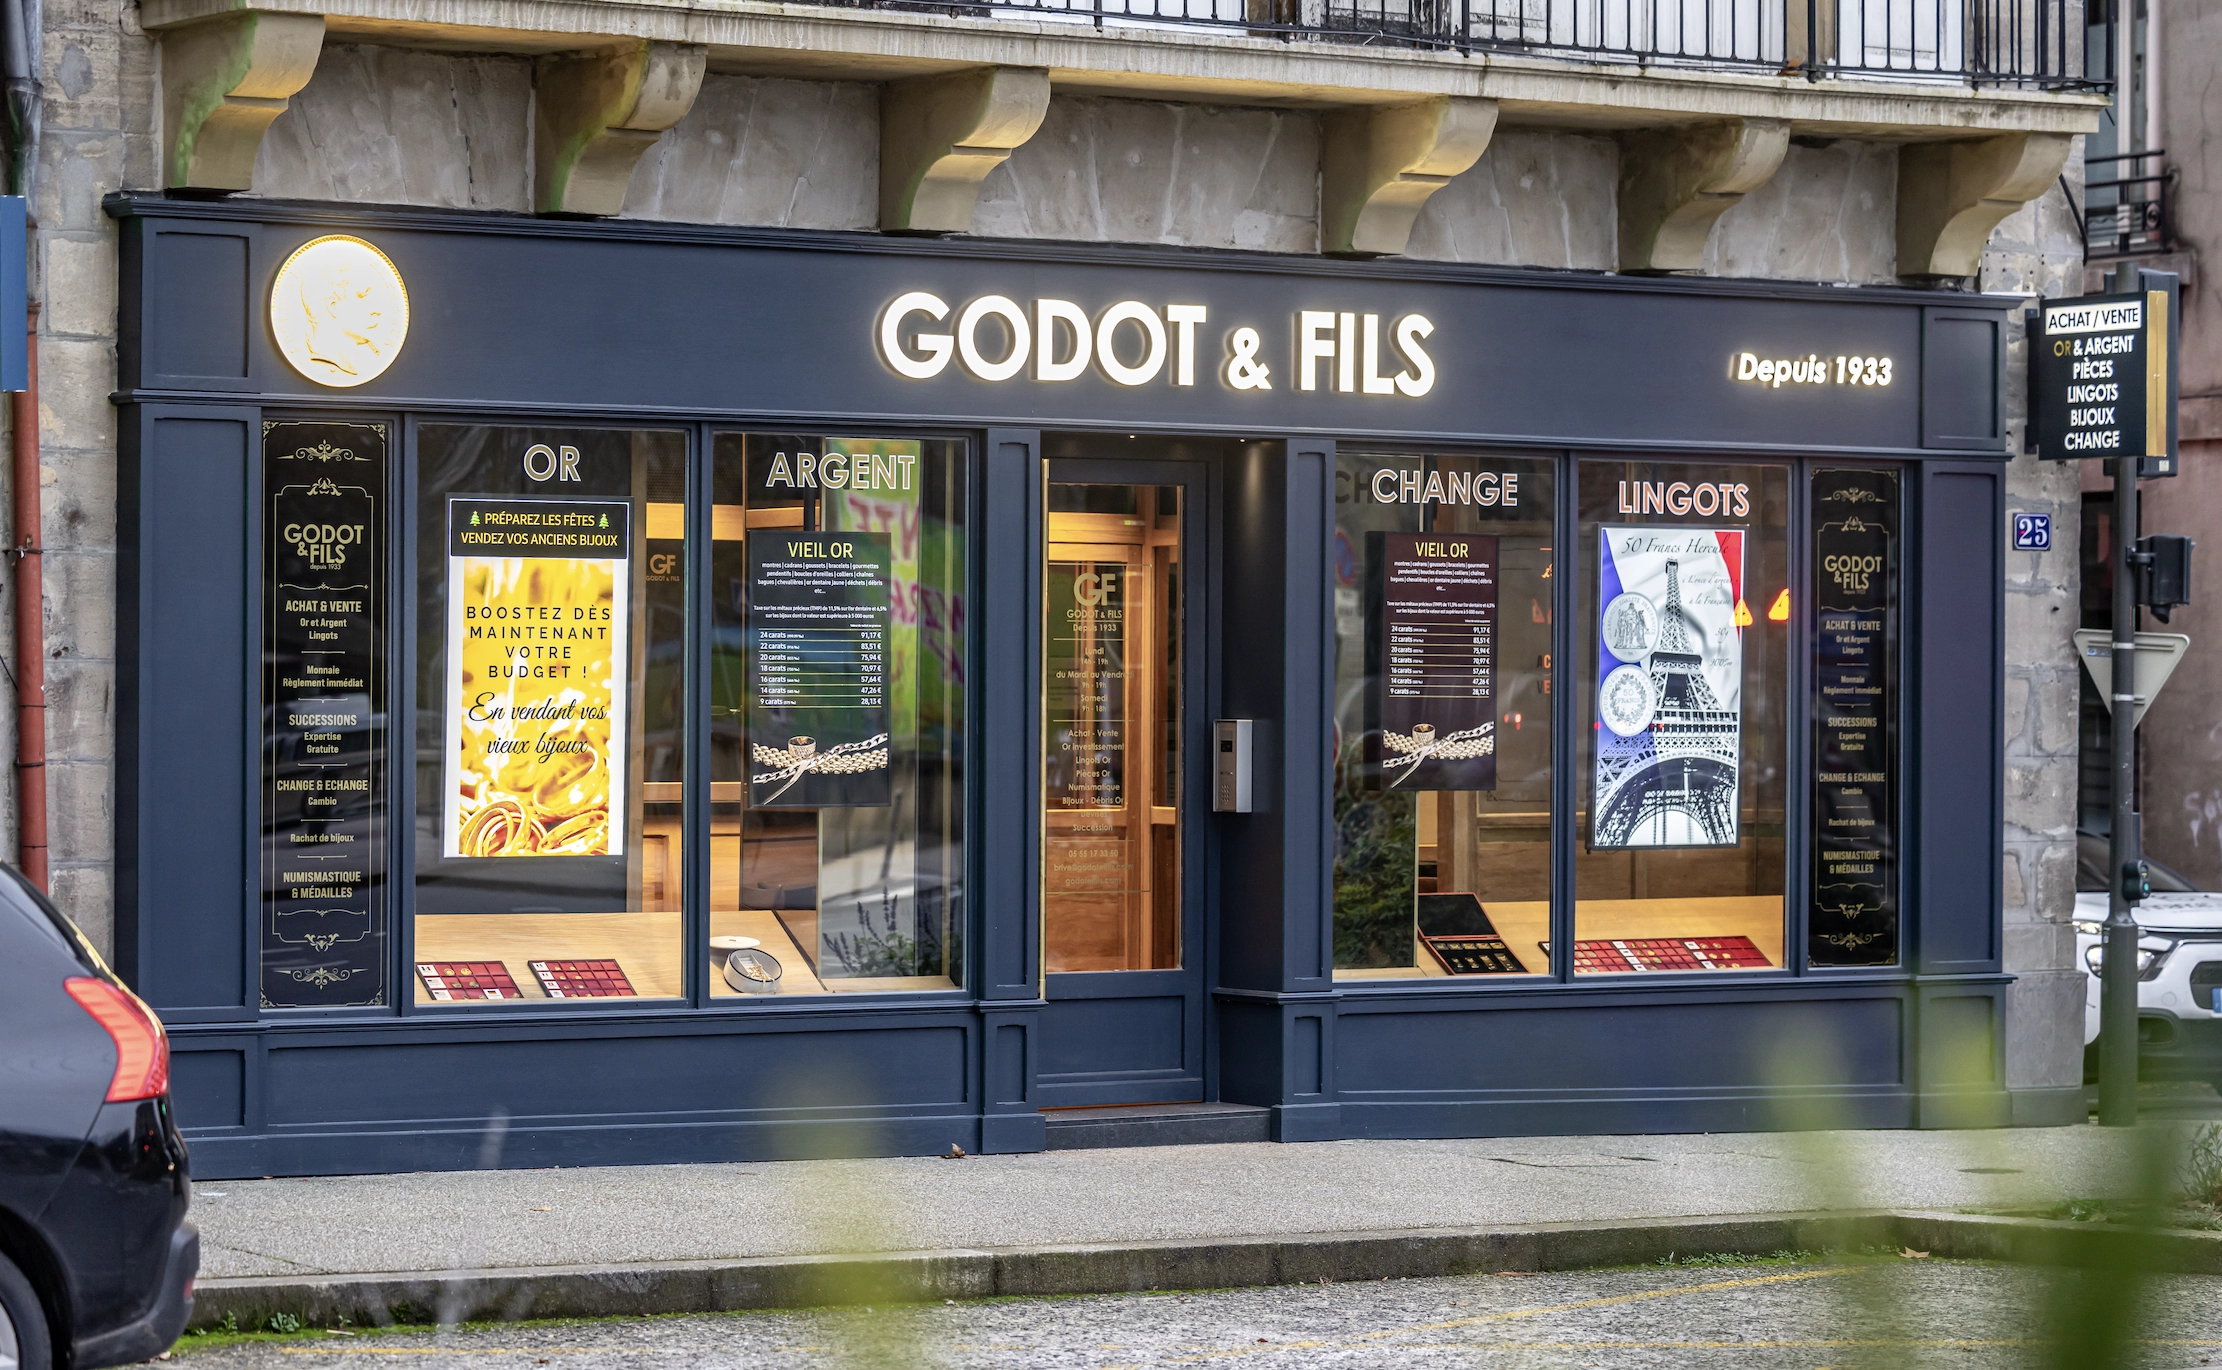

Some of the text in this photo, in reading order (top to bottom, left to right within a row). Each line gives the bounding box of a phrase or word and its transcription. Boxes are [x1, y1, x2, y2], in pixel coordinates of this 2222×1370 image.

[2048, 307, 2139, 330] ACHAT / VENTE
[880, 291, 1435, 397] GODOT & FILS
[2053, 335, 2134, 357] OR & ARGENT
[1737, 352, 1893, 388] Depuis 1933
[2073, 357, 2114, 379] PIÈCES
[2067, 383, 2119, 404] LINGOTS
[2070, 407, 2116, 427] BIJOUX
[2064, 430, 2120, 450] CHANGE
[524, 444, 581, 482] OR
[765, 452, 915, 490] ARGENT
[1372, 468, 1518, 506] CHANGE
[1618, 480, 1750, 517] LINGOTS
[484, 511, 595, 527] PRÉPAREZ LES FÊTES
[284, 523, 364, 544] GODOT
[2018, 517, 2048, 546] 25
[461, 532, 618, 546] VENDEZ VOS ANCIENS BIJOUX
[1621, 532, 1731, 554] 50 Francs Hercule
[297, 541, 346, 564] & FILS
[787, 541, 853, 559] VIEIL OR
[1415, 542, 1469, 558] VIEIL OR
[310, 563, 327, 571] depuis
[650, 554, 676, 574] GF
[1824, 555, 1882, 573] GODOT
[1834, 570, 1869, 590] & FILS
[1073, 572, 1116, 606] GF
[285, 600, 362, 613] ACHAT & VENTE
[466, 604, 610, 620] BOOSTEZ DÈS
[1066, 609, 1122, 619] GODOT & FILS
[300, 618, 347, 629] Or et Argent
[1073, 624, 1117, 632] Depuis 1933
[1825, 620, 1881, 631] ACHAT & VENTE
[309, 631, 339, 641] Lingots
[470, 626, 607, 640] MAINTENANT
[505, 646, 571, 659] VOTRE
[1085, 647, 1104, 655] Lundi
[1842, 646, 1864, 655] Lingots
[760, 653, 768, 661] 20
[768, 653, 786, 661] carats
[307, 665, 340, 675] Monnaie
[489, 665, 587, 679] BUDGET !
[282, 677, 364, 689] Règlement immédiat
[1080, 694, 1108, 702] Samedi
[468, 692, 608, 721] En vendant vos
[288, 714, 357, 726] SUCCESSIONS
[1827, 717, 1878, 727] SUCCESSIONS
[304, 732, 342, 742] Expertise
[1068, 729, 1119, 737] Achat Vente
[1838, 732, 1866, 741] Expertise
[306, 744, 339, 754] Gratuite
[487, 732, 588, 764] vieux bijoux
[1840, 742, 1865, 751] Gratuite
[1075, 756, 1100, 765] Lingots
[1076, 769, 1100, 778] Pièces
[1819, 772, 1886, 782] CHANGE & ECHANGE
[277, 780, 368, 791] CHANGE & ECHANGE
[1068, 783, 1120, 792] Numismatique
[1841, 787, 1863, 795] Cambio
[308, 796, 337, 806] Cambio
[1062, 796, 1084, 806] Bijoux
[1090, 796, 1114, 805] Débris
[290, 833, 355, 844] Rachat de bijoux
[1823, 850, 1880, 861] NUMISMASTIQUE
[1829, 862, 1874, 874] & MÉDAILLES
[283, 871, 362, 883] NUMISMASTIQUE
[291, 886, 353, 898] & MÉDAILLES
